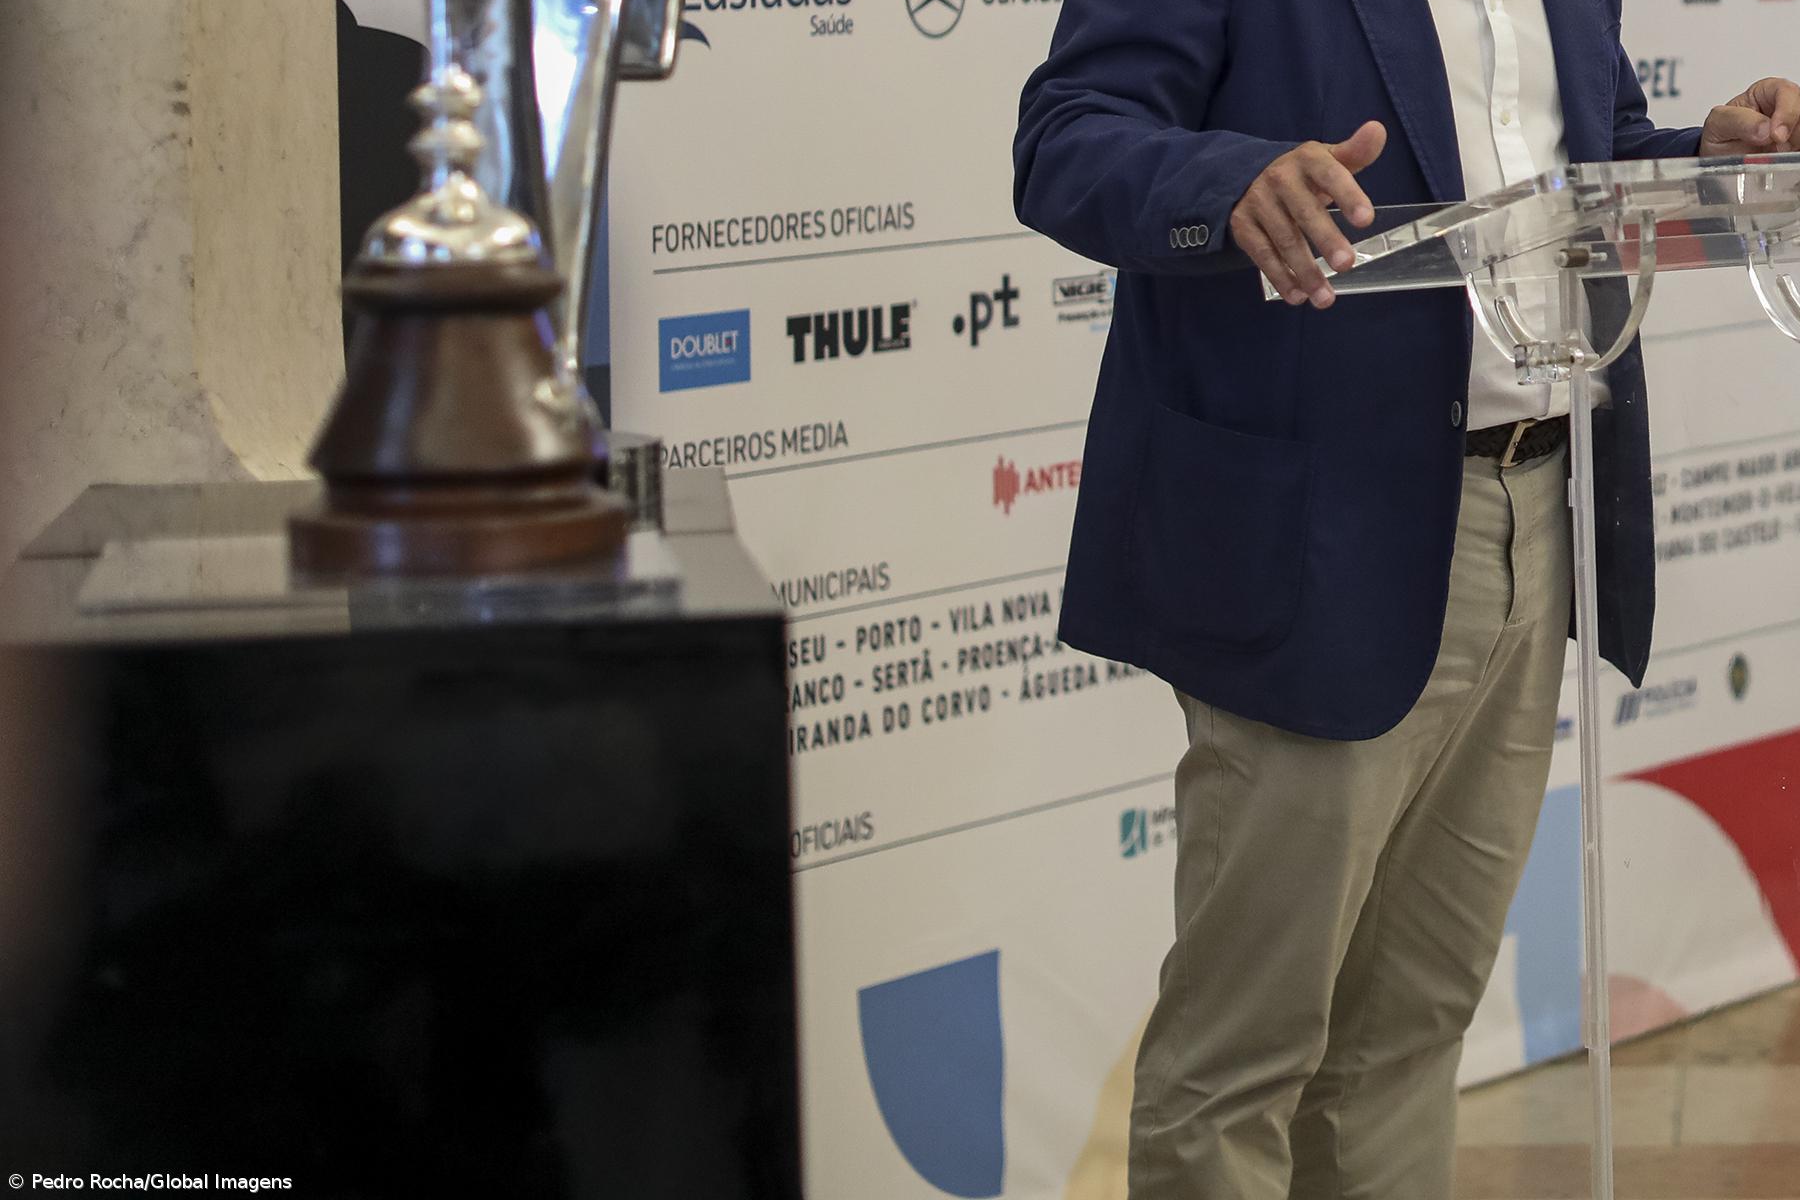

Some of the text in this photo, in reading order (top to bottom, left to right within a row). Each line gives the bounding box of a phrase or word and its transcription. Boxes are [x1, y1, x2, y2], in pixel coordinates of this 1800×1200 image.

[810, 15, 855, 37] Saúde
[651, 202, 915, 254] FORNECEDORES OFICIAIS
[786, 301, 912, 364] THULE
[952, 272, 1021, 349] .pt
[671, 330, 738, 360] DOUBLET
[781, 418, 849, 456] MEDIA
[855, 615, 922, 654] PORTO
[949, 603, 995, 635] VILA
[1002, 590, 1052, 624] NOVA
[872, 651, 933, 694] SERTÃ
[882, 704, 911, 734] DO
[921, 684, 992, 726] CORVO
[1018, 660, 1099, 703] ÁGUEDA
